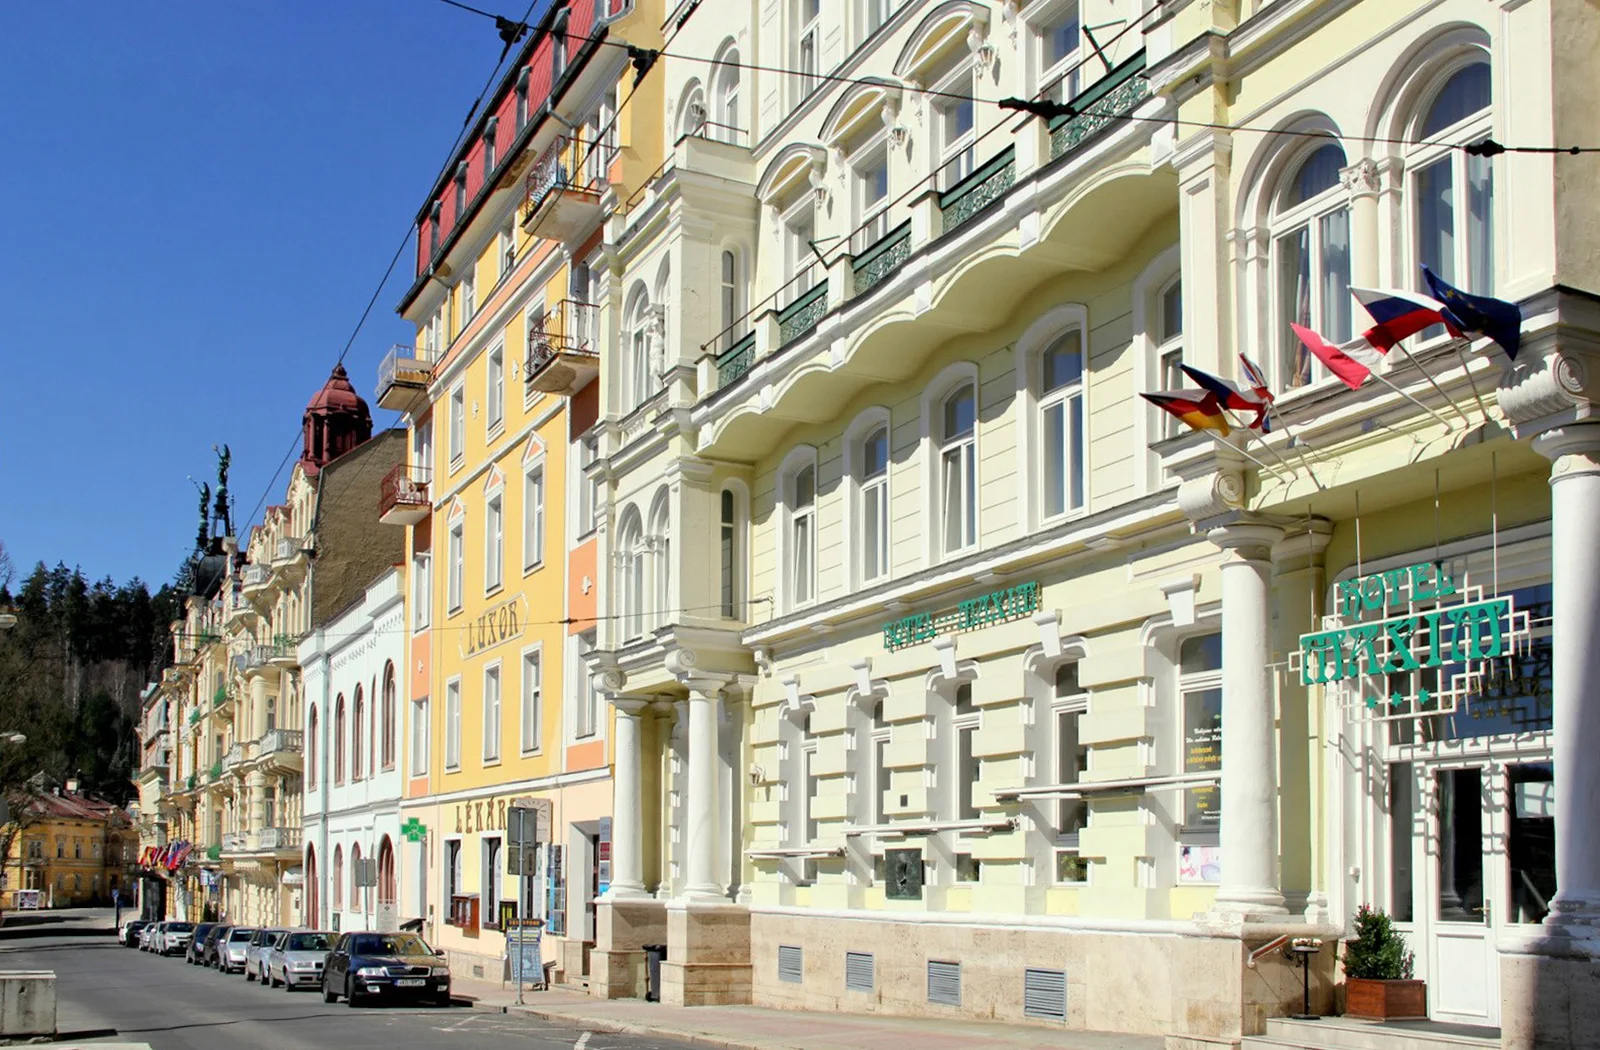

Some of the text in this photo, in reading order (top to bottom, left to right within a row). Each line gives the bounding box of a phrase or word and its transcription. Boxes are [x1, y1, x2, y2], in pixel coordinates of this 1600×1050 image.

[882, 580, 1038, 654] HOTEL MAXIM
[1339, 560, 1456, 621] HOTEL
[468, 600, 518, 655] LUXOR
[1300, 599, 1509, 685] MAXIM
